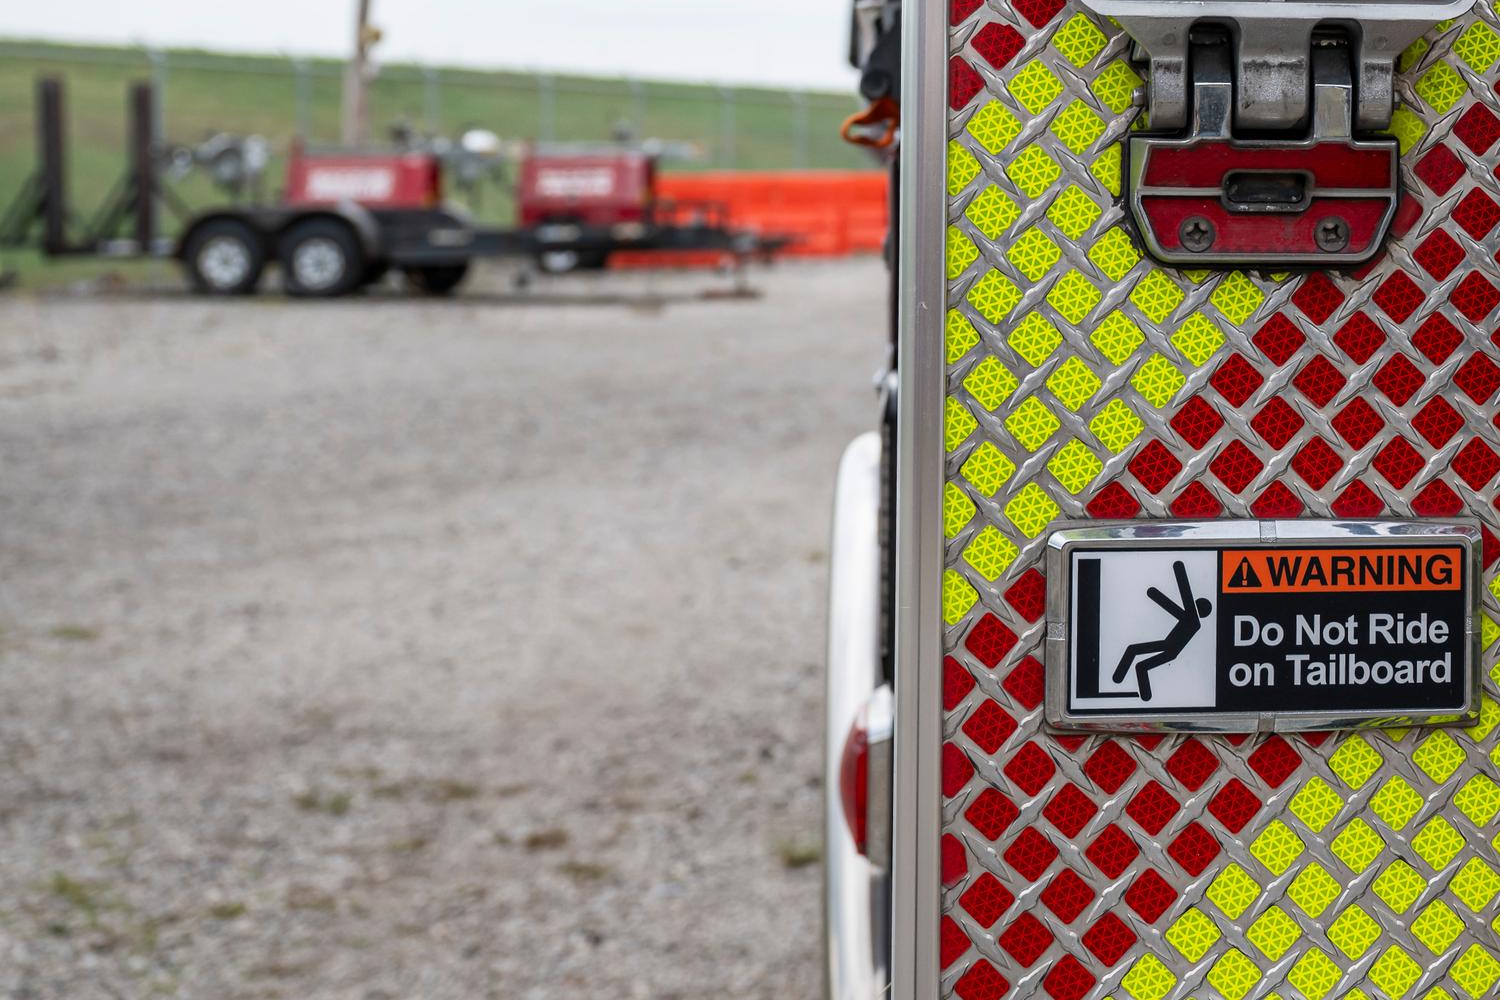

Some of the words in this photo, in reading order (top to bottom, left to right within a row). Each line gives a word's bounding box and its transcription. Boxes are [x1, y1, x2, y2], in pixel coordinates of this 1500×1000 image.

[1266, 554, 1454, 587] WARNING
[1233, 614, 1284, 647] Do
[1295, 613, 1359, 646] Not
[1368, 612, 1450, 645] Ride
[1229, 660, 1274, 687] on
[1285, 652, 1453, 687] Tailboard
